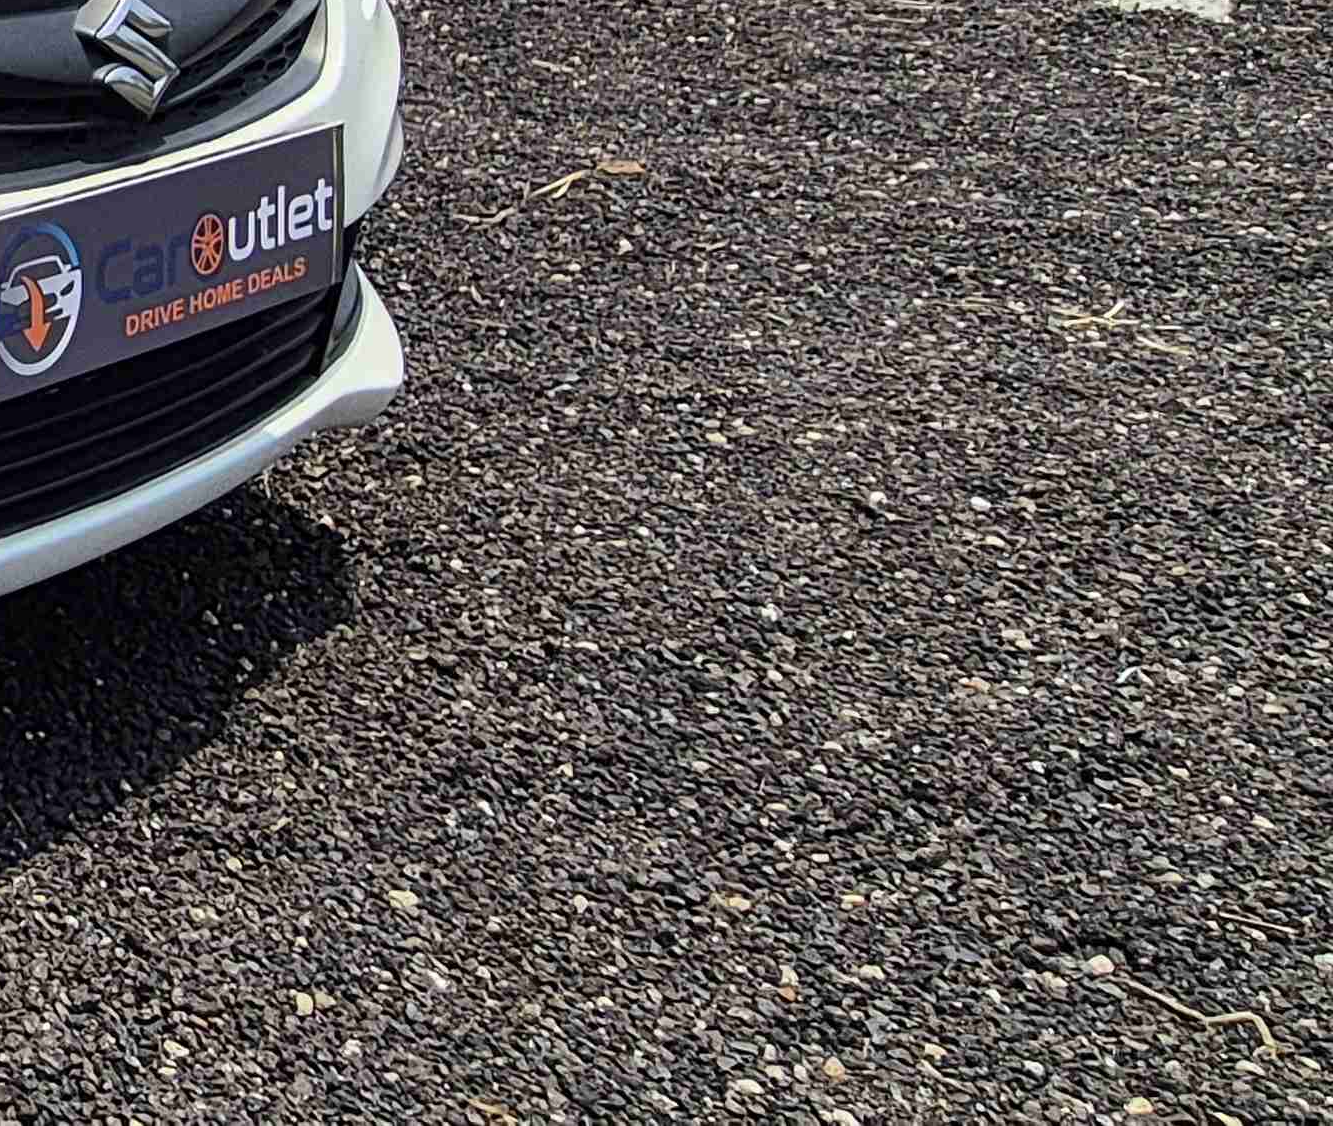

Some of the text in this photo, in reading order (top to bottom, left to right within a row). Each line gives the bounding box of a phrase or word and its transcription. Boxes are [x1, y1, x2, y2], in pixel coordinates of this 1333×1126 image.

[125, 257, 308, 337] DRIVE HOME DEALS
